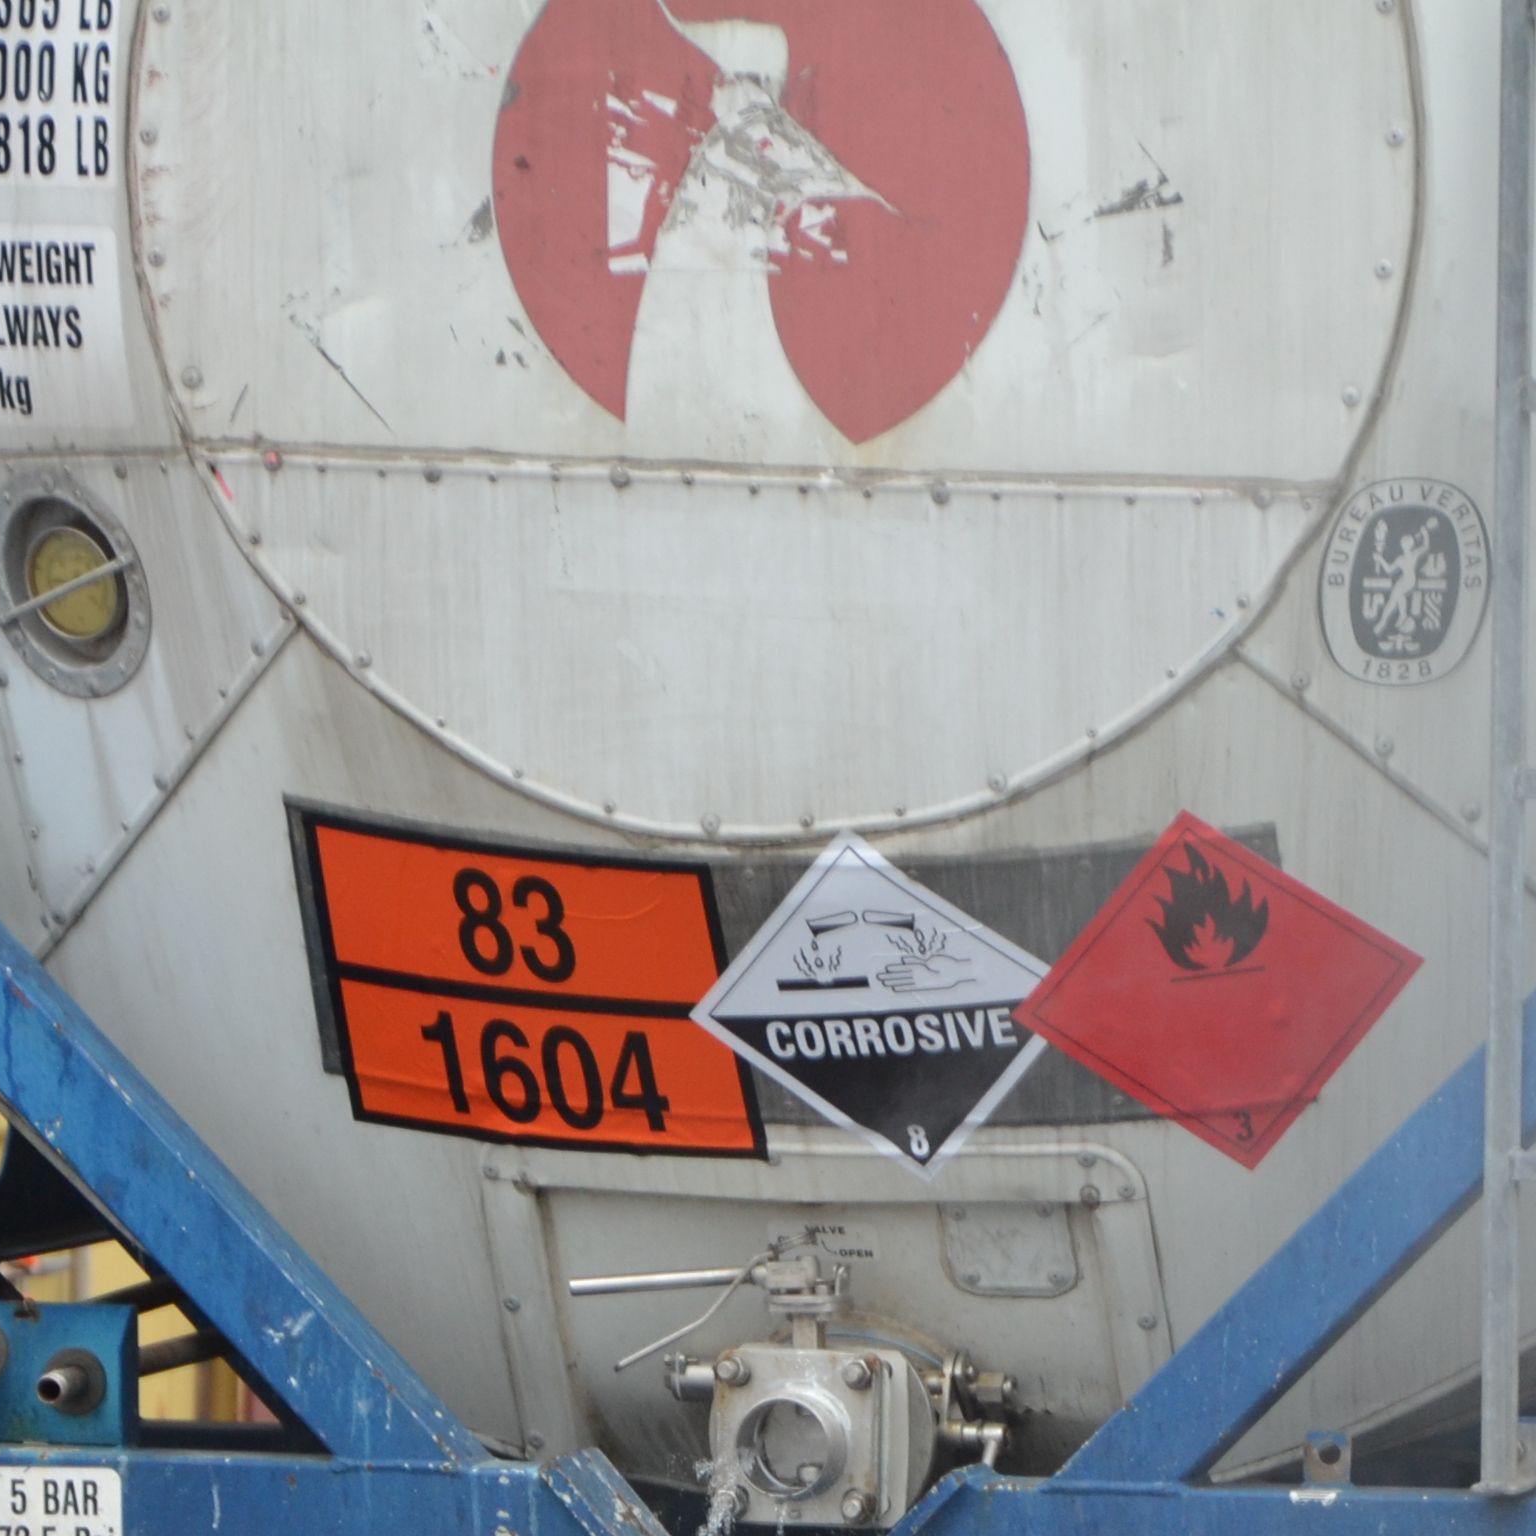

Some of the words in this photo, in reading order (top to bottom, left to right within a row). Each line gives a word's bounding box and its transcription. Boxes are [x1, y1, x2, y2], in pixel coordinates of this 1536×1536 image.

[73, 42, 110, 103] KG
[77, 116, 109, 176] LB
[1328, 484, 1404, 587] BUREAU
[1420, 484, 1483, 590] VERITAS
[1364, 659, 1432, 681] 1828
[452, 868, 576, 982] 83
[765, 1005, 1020, 1064] CORROSIVE
[420, 1010, 670, 1132] 1604
[907, 1123, 931, 1160] 8
[1234, 1109, 1255, 1144] 3
[839, 1248, 874, 1258] OPEN
[10, 1479, 26, 1515] 5
[43, 1479, 98, 1516] BAR
